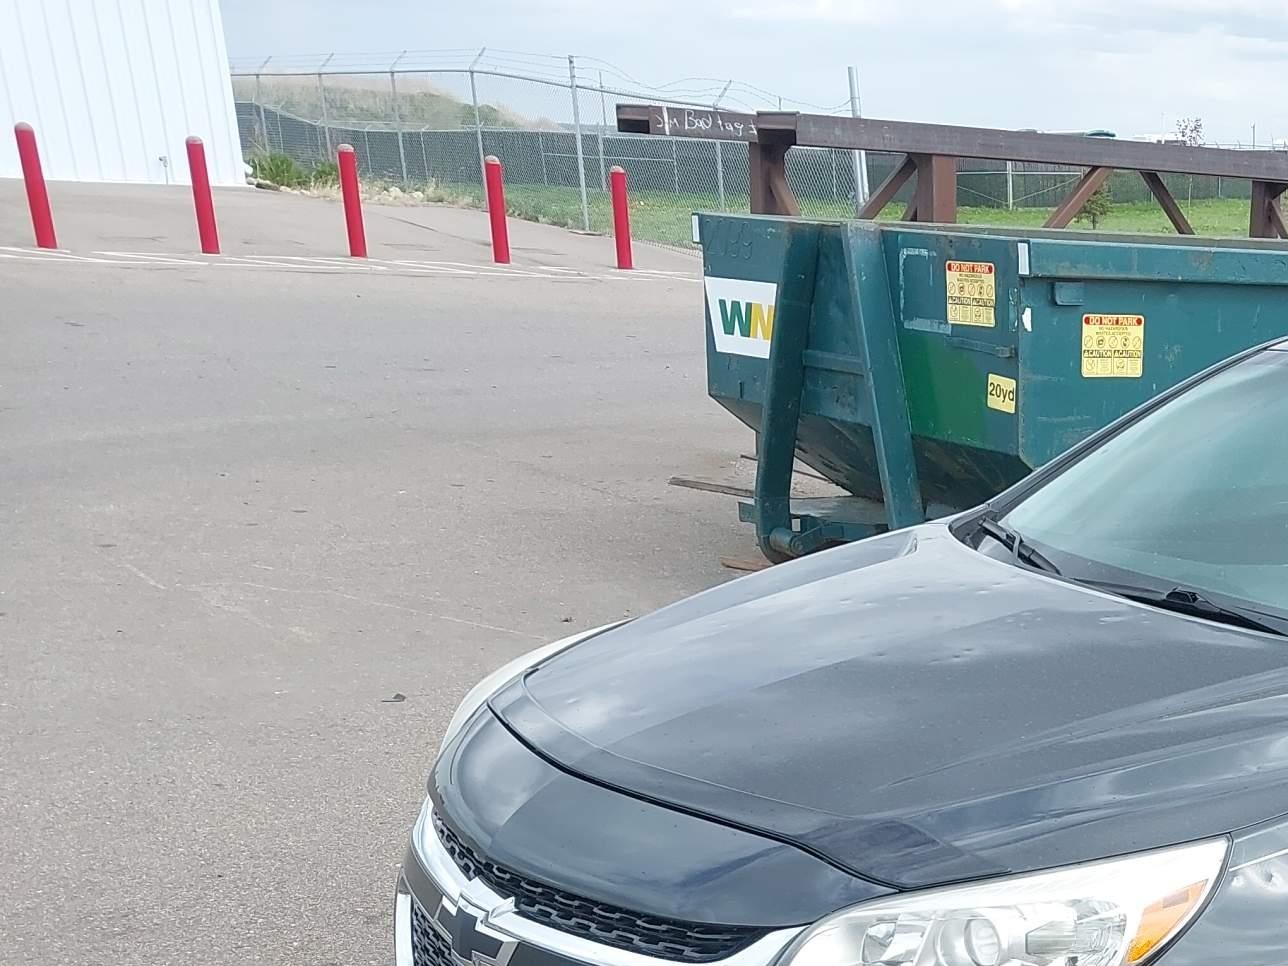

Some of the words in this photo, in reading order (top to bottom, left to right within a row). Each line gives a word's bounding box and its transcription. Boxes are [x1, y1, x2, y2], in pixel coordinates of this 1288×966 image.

[951, 263, 960, 272] DO
[960, 264, 973, 272] NOT
[974, 264, 990, 274] PARK
[1089, 316, 1100, 325] DO
[1102, 316, 1118, 325] NOT
[1119, 317, 1136, 326] PARK
[1089, 350, 1112, 358] CAUTION
[1120, 350, 1140, 358] CAUTION
[989, 382, 1015, 403] 20yd
